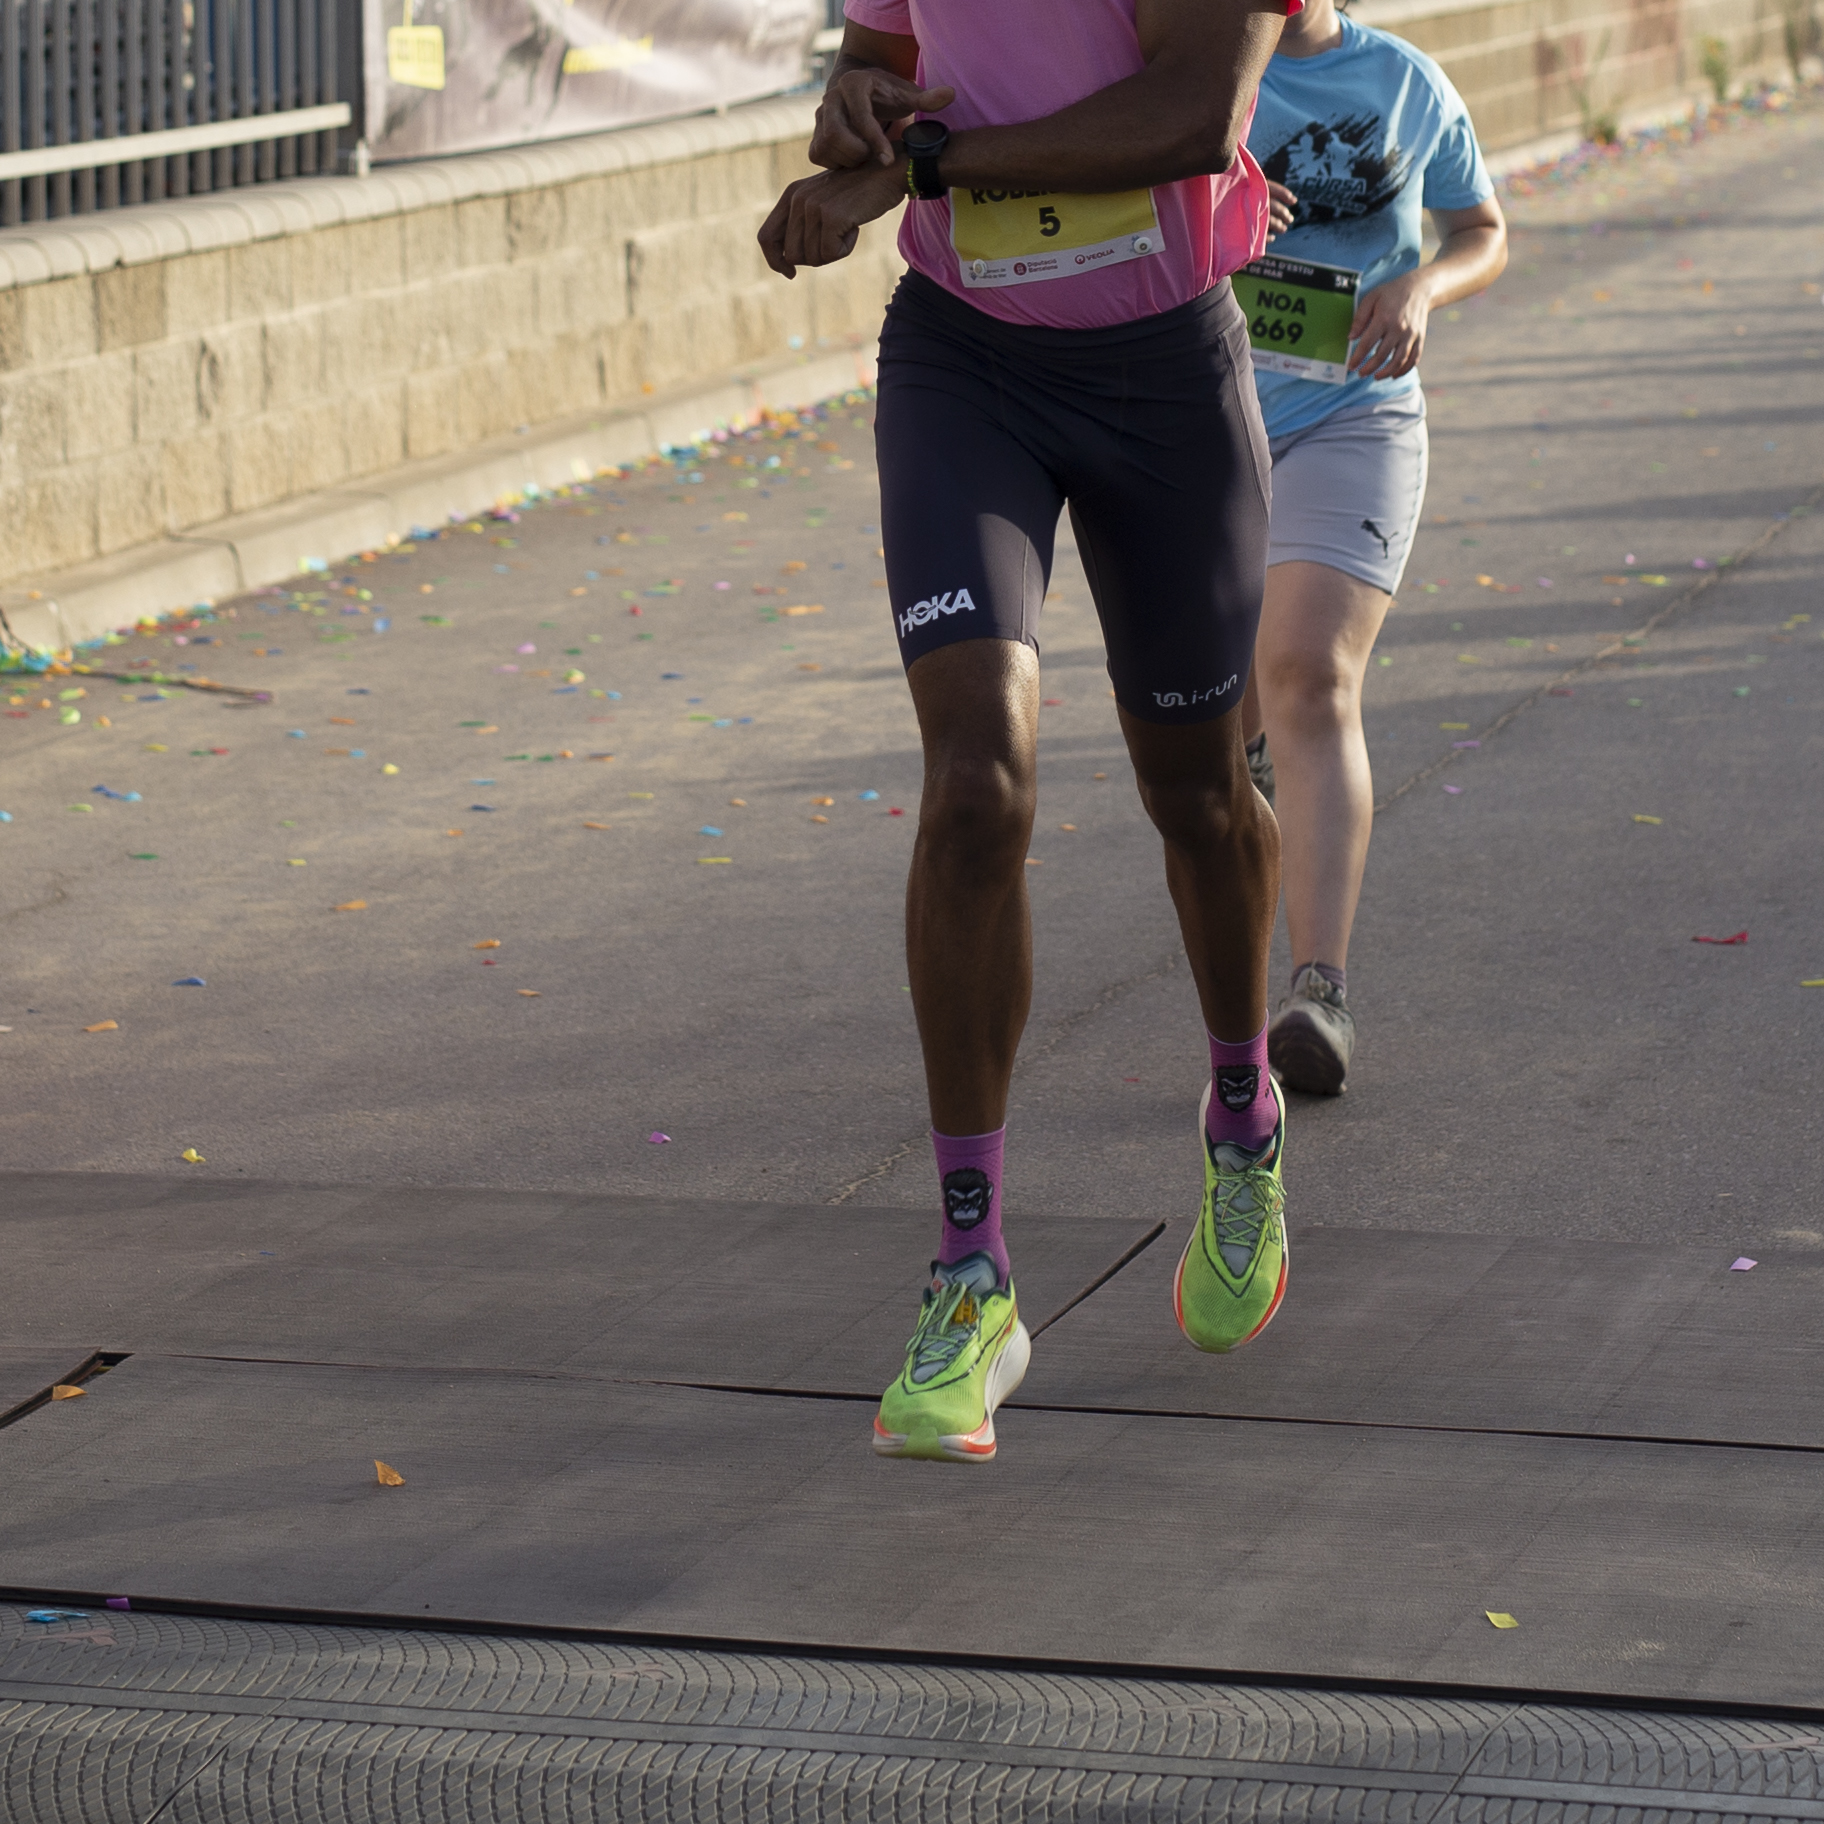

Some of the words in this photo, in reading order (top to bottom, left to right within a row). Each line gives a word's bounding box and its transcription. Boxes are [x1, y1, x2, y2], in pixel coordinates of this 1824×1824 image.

[1038, 205, 1061, 237] 5
[1086, 249, 1114, 261] VEOLIA
[1256, 289, 1307, 316] NOA
[1251, 315, 1304, 345] 669
[899, 588, 976, 638] HOKA
[1192, 673, 1238, 704] i-run
